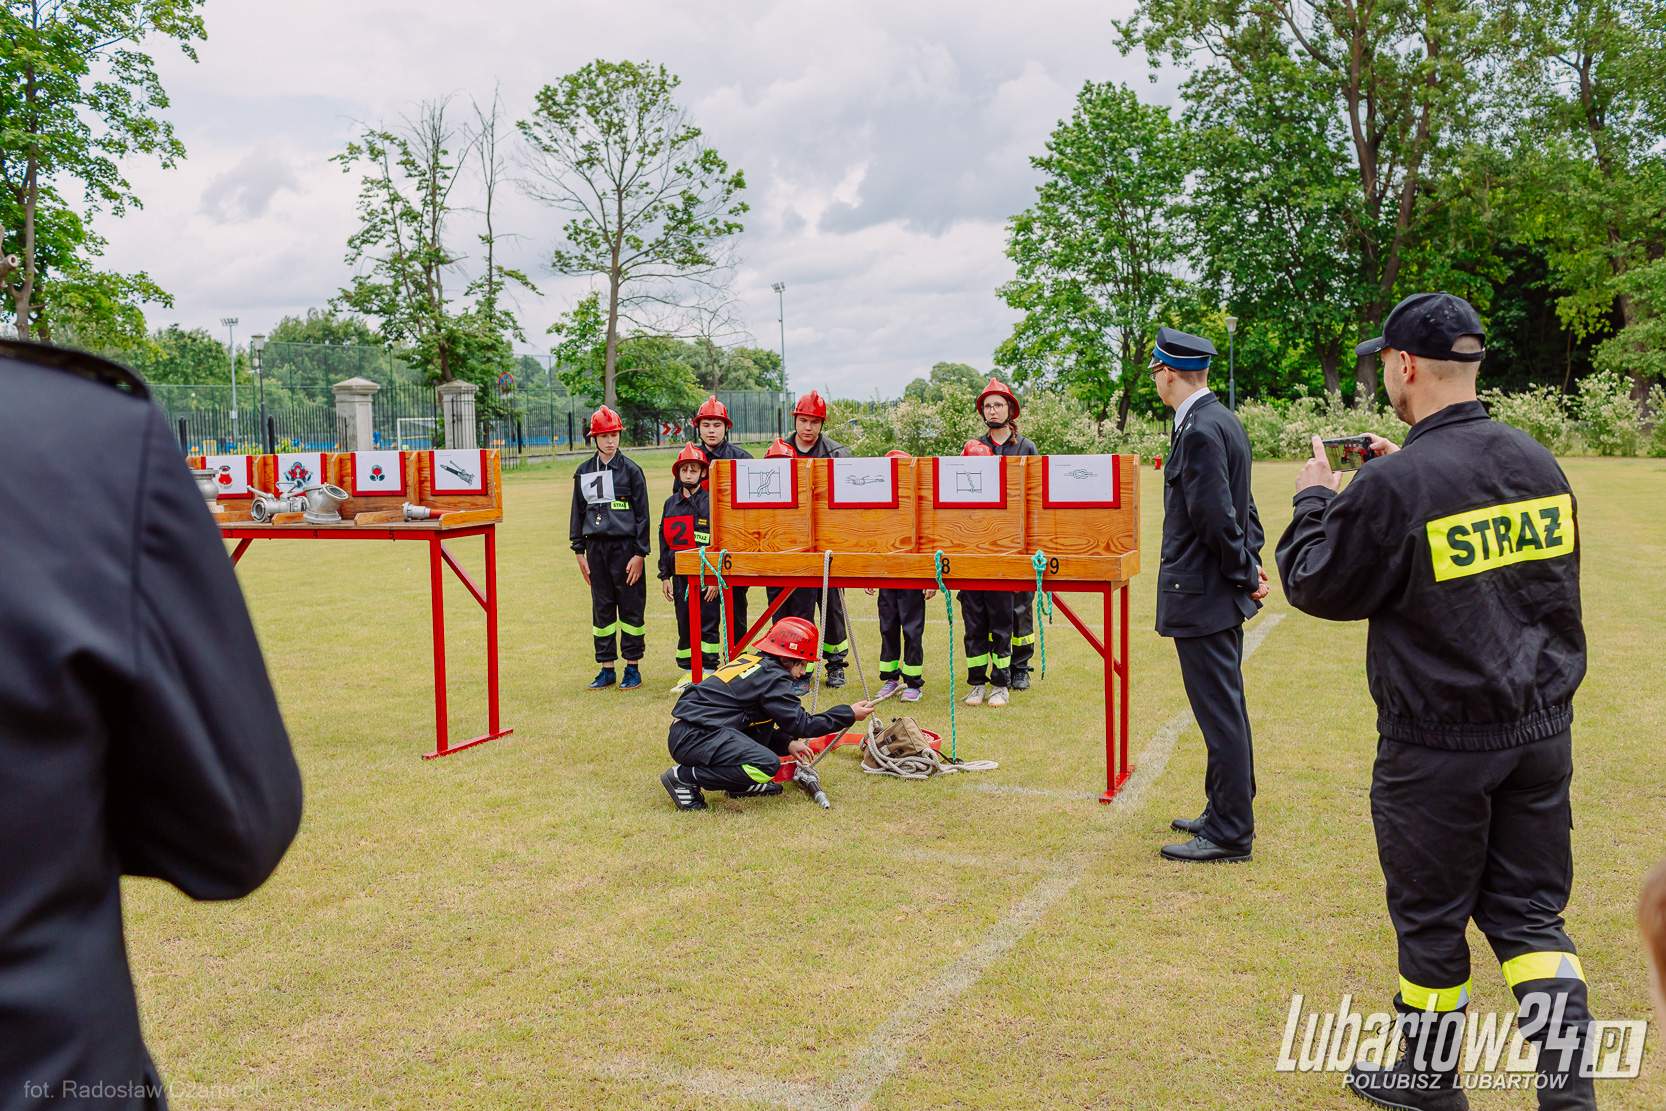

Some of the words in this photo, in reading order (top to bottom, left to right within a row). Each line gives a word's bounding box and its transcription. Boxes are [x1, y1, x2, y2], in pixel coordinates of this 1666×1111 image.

[590, 475, 604, 499] 1
[671, 521, 688, 545] 2
[724, 553, 732, 570] 6
[941, 557, 950, 574] 8
[1049, 557, 1059, 574] 9
